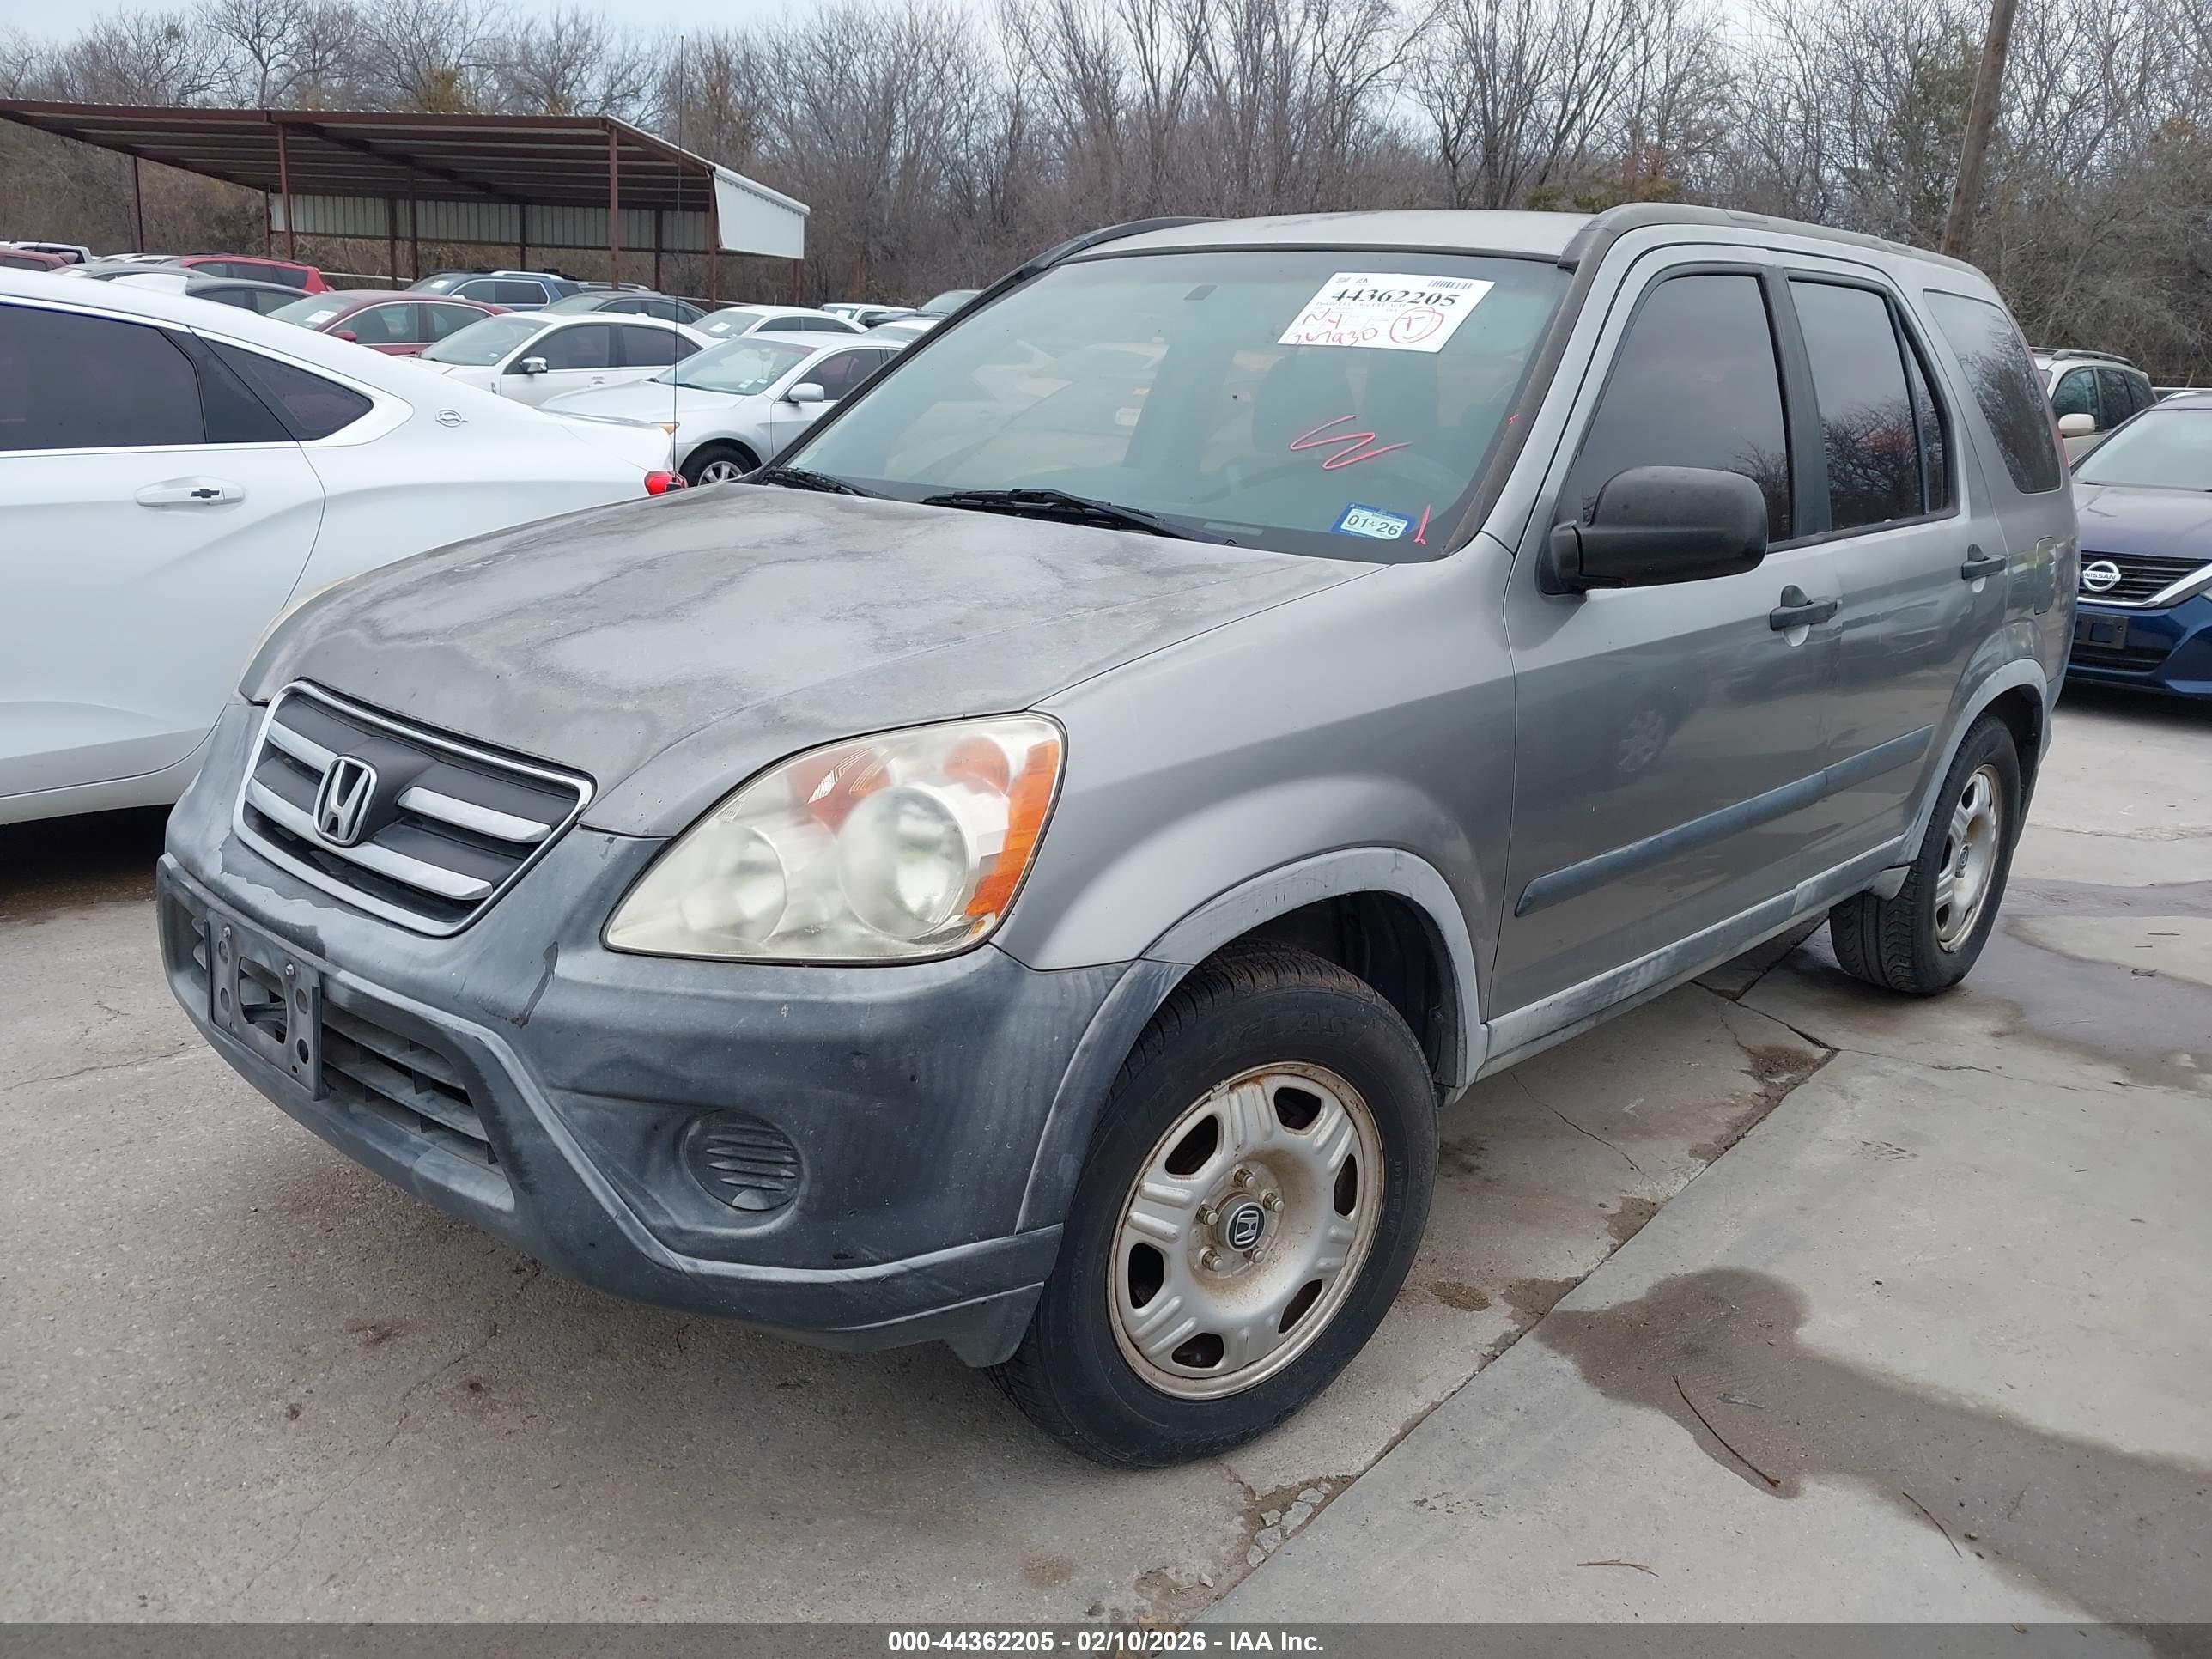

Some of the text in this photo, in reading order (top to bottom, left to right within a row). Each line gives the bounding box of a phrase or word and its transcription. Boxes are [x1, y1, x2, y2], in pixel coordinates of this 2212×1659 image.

[1332, 289, 1460, 307] 44362205
[1347, 514, 1369, 529] 01
[1376, 521, 1401, 536] 26
